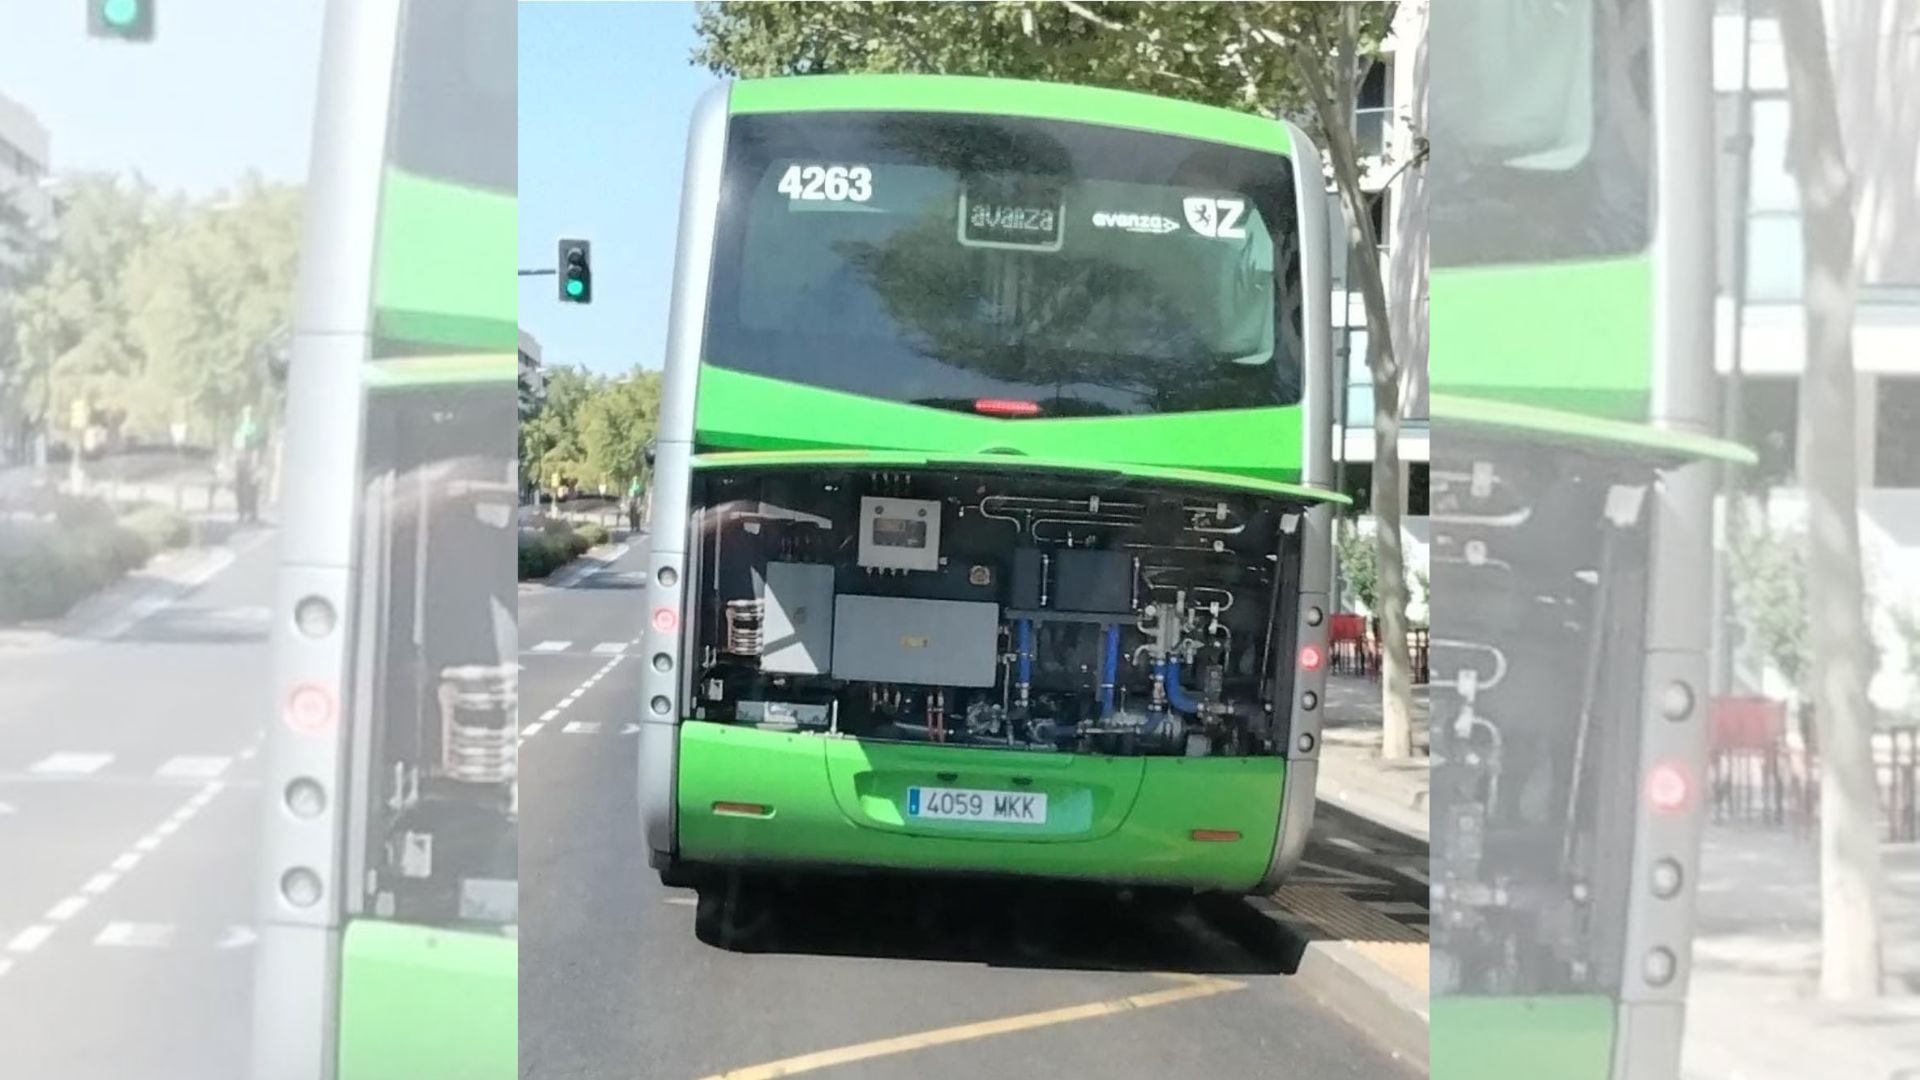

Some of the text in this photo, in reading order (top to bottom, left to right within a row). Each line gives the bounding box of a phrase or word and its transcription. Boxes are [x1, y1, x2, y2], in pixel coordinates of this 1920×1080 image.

[778, 165, 872, 202] 4263
[970, 205, 1054, 232] avanza
[1092, 213, 1163, 230] avanza
[1216, 199, 1247, 239] Z
[927, 792, 1036, 819] 4059 MKK
